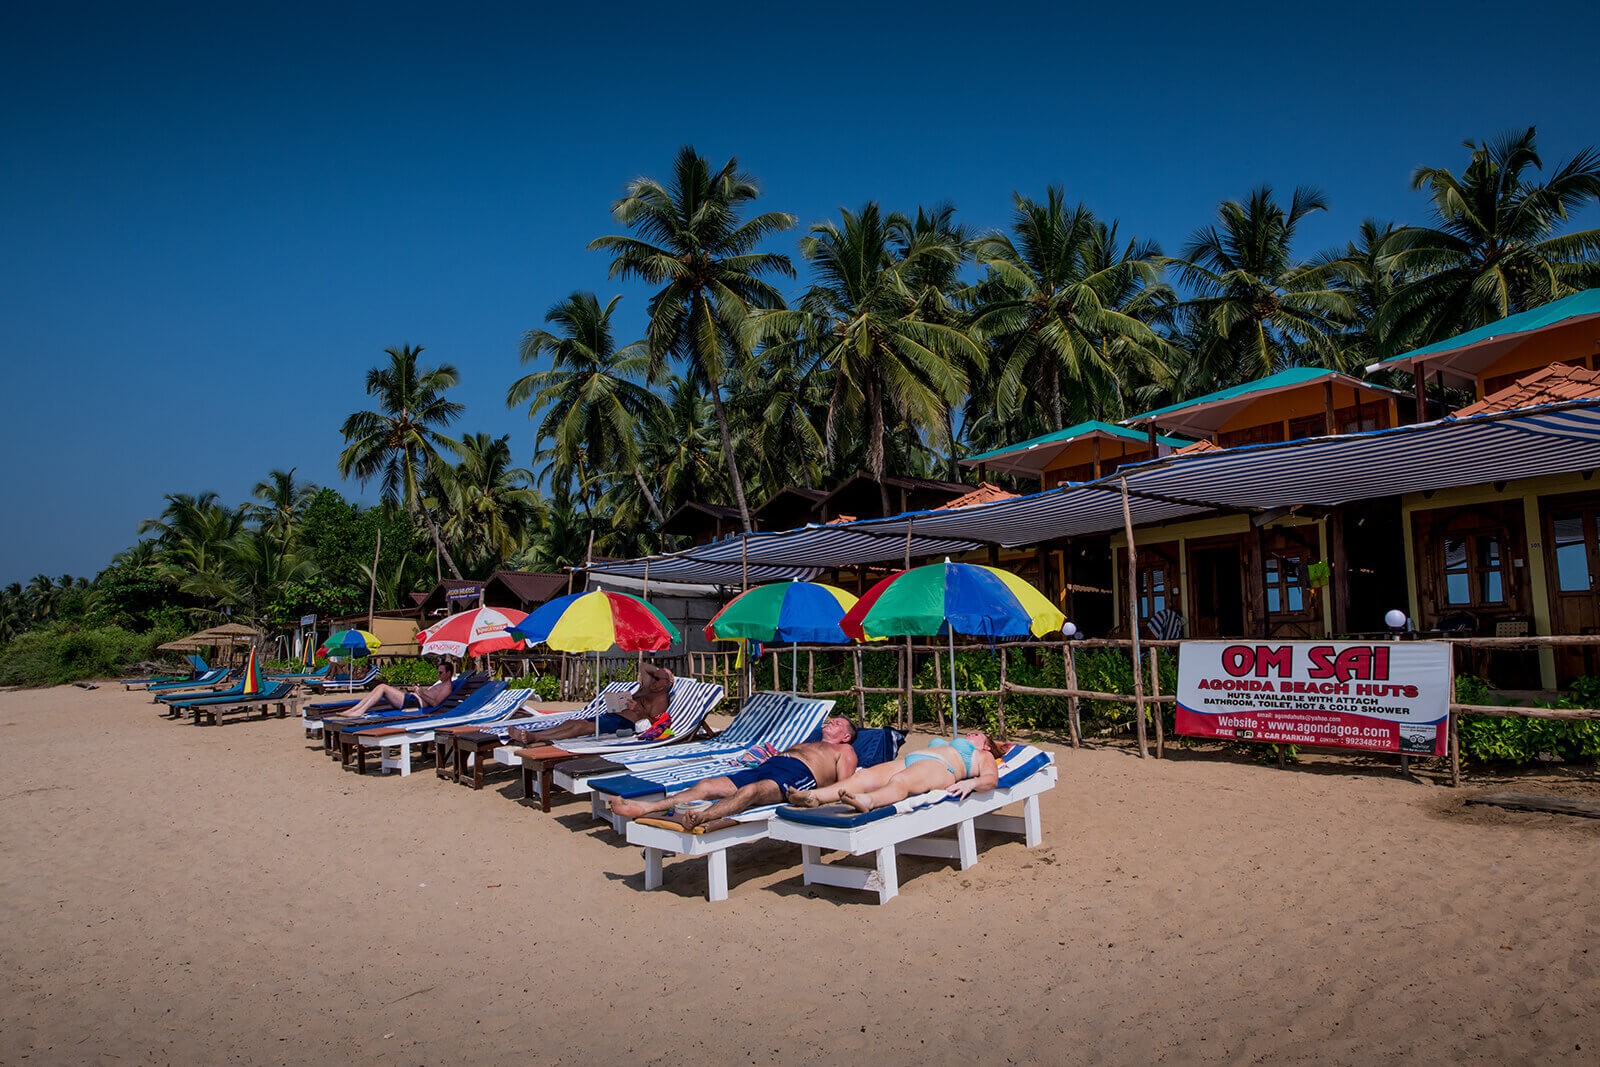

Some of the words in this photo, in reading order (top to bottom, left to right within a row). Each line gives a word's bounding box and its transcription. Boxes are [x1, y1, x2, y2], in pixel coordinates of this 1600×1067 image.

[1221, 644, 1293, 678] OM
[1307, 645, 1391, 684] SAI
[1198, 678, 1275, 692] AGONDA
[1280, 681, 1349, 695] BEACH
[1356, 683, 1419, 698] HUTS
[1204, 698, 1256, 708] BATHROOM,
[1258, 701, 1293, 709] TOILET,
[1329, 704, 1358, 712] COLD
[1361, 705, 1410, 715] SHOWER
[1227, 692, 1251, 700] HUTS
[1254, 693, 1304, 702] AVAILABLE
[1308, 695, 1333, 703] WITH
[1336, 697, 1379, 705] ATTACH
[1216, 728, 1233, 736] FREE
[1264, 731, 1280, 739] CAR
[1281, 733, 1316, 742] PARKING
[1218, 716, 1258, 729] Website
[1267, 721, 1390, 738] www.agondagoa.com
